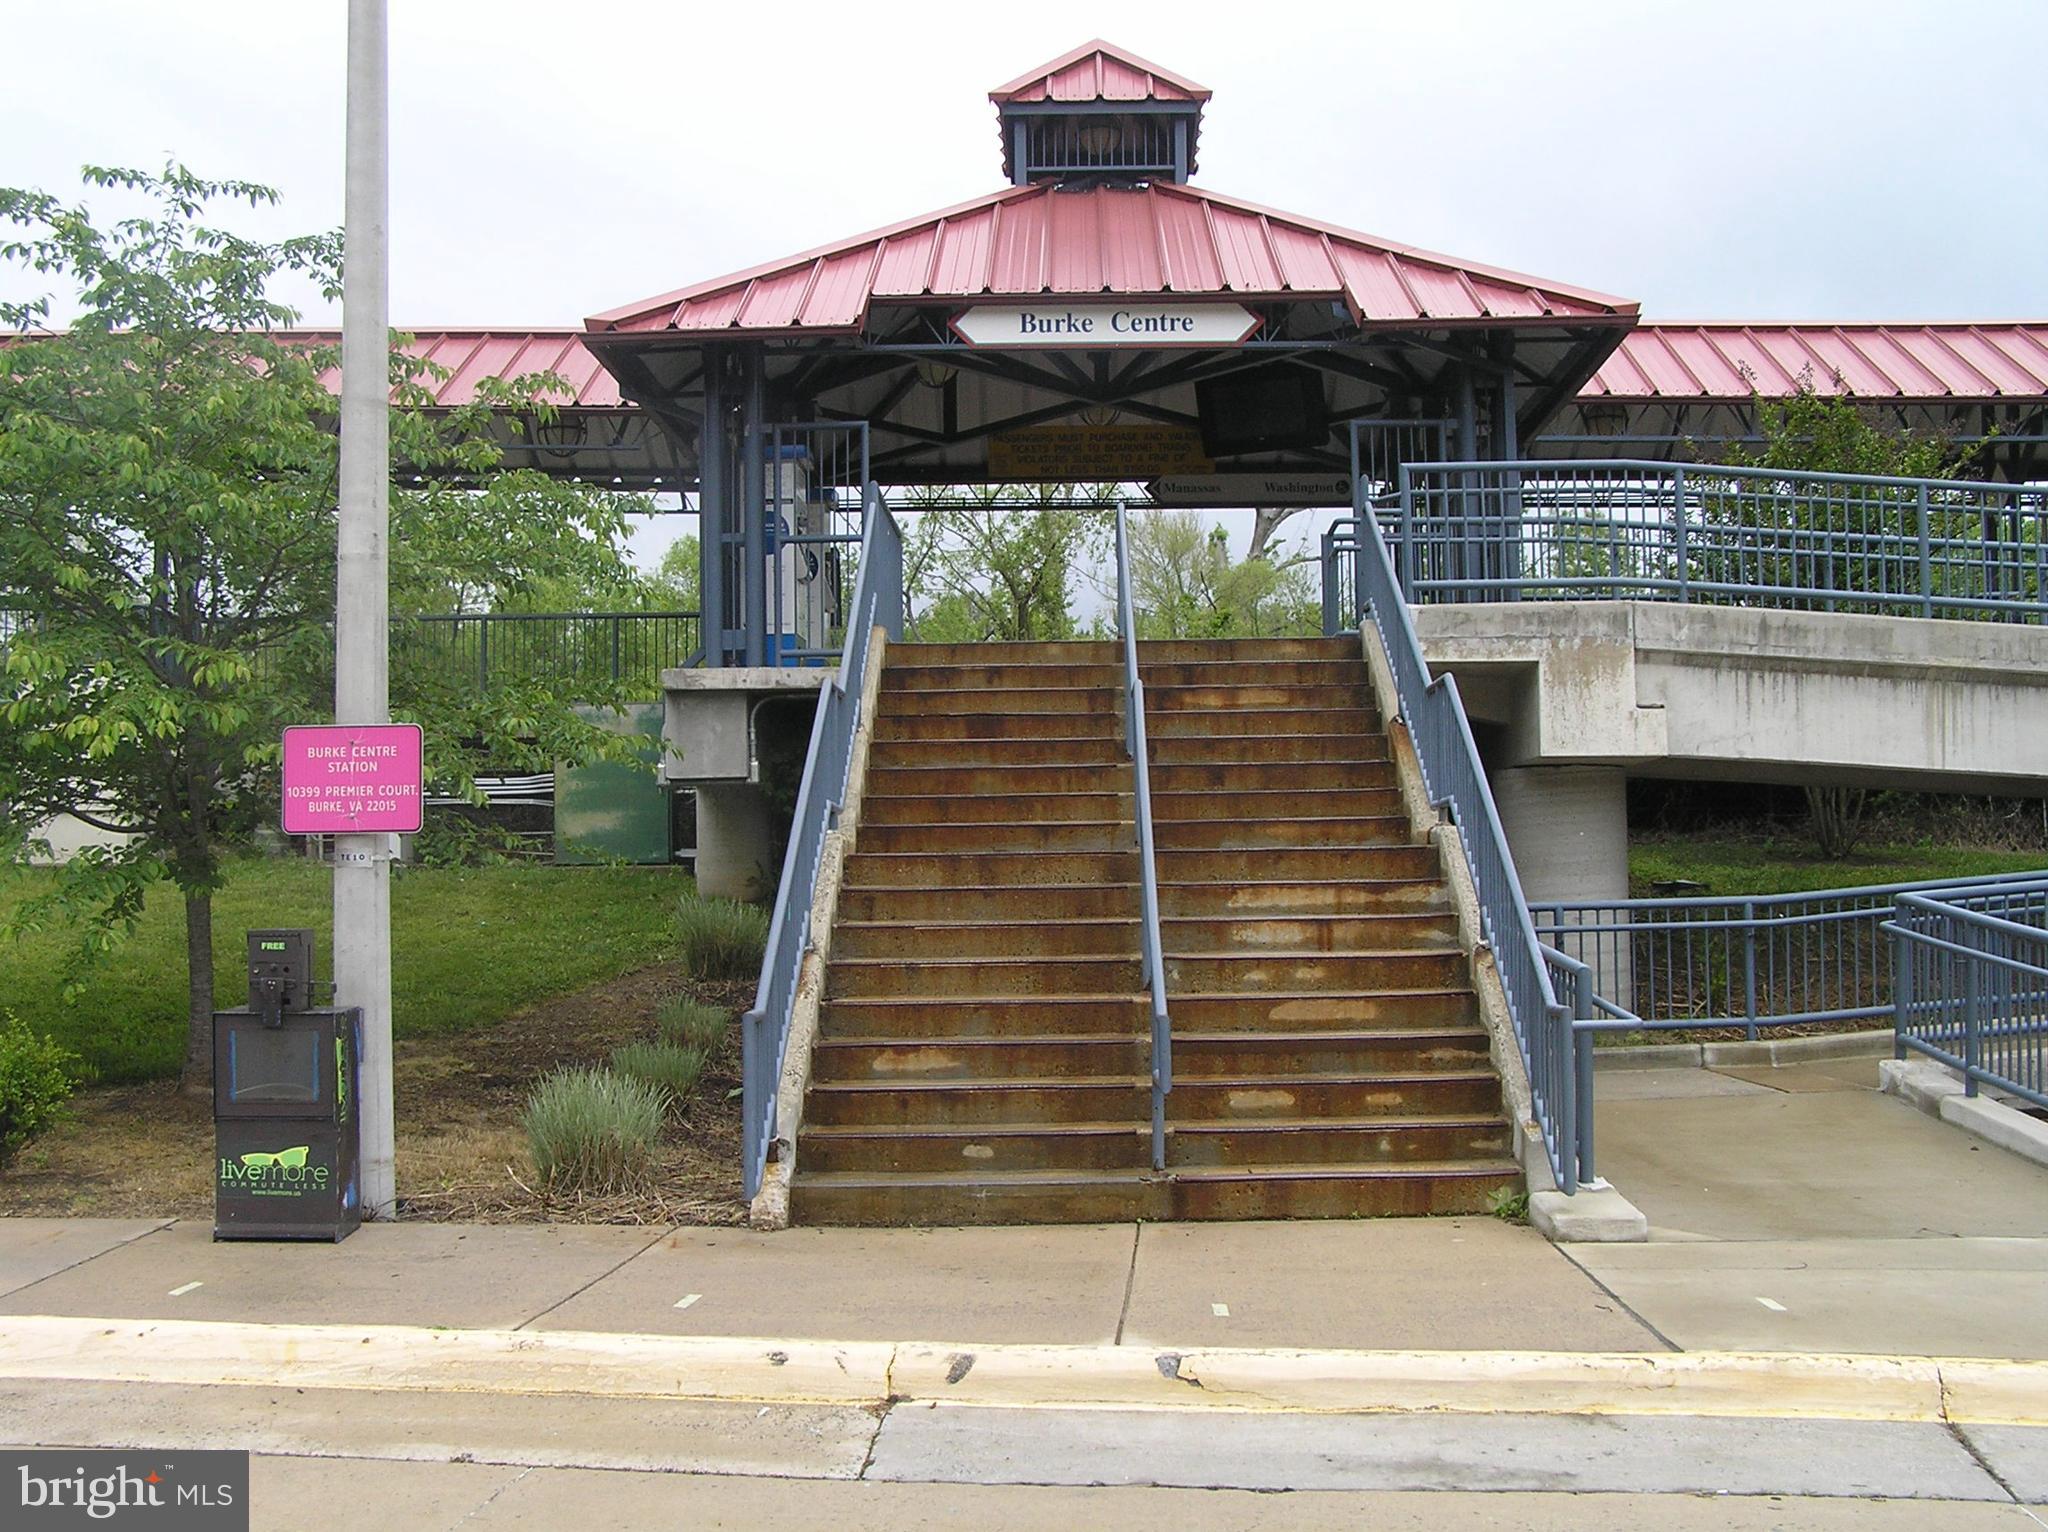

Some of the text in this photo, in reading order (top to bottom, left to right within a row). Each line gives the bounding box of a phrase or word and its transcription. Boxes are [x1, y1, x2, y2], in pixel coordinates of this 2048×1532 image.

[1020, 311, 1194, 333] Burke Centre
[1057, 432, 1084, 443] MUST
[1089, 431, 1138, 442] PURCHASE
[1143, 431, 1164, 442] AND
[1011, 443, 1048, 453] TICKETS
[1054, 443, 1082, 453] PRIOR
[1087, 443, 1101, 453] TO
[1105, 443, 1152, 453] BOARDING
[1016, 454, 1068, 464] VIOLATORS
[1073, 454, 1113, 464] SUBJECT
[1119, 454, 1133, 463] TO
[1137, 454, 1145, 463] A
[1148, 454, 1169, 463] FINE
[1040, 464, 1059, 474] NOT
[1063, 464, 1089, 474] LESS
[1095, 464, 1119, 474] THAN
[1164, 482, 1334, 495] Manassas Washington
[307, 746, 397, 758] BURKE CENTRE
[328, 761, 378, 773] STATION
[287, 785, 418, 797] 10399 PREMIER COURT.
[308, 801, 396, 813] BURKE, VA 22015
[261, 942, 285, 950] FREE
[220, 1158, 329, 1182] livemore
[221, 1181, 284, 1189] COMMUTE
